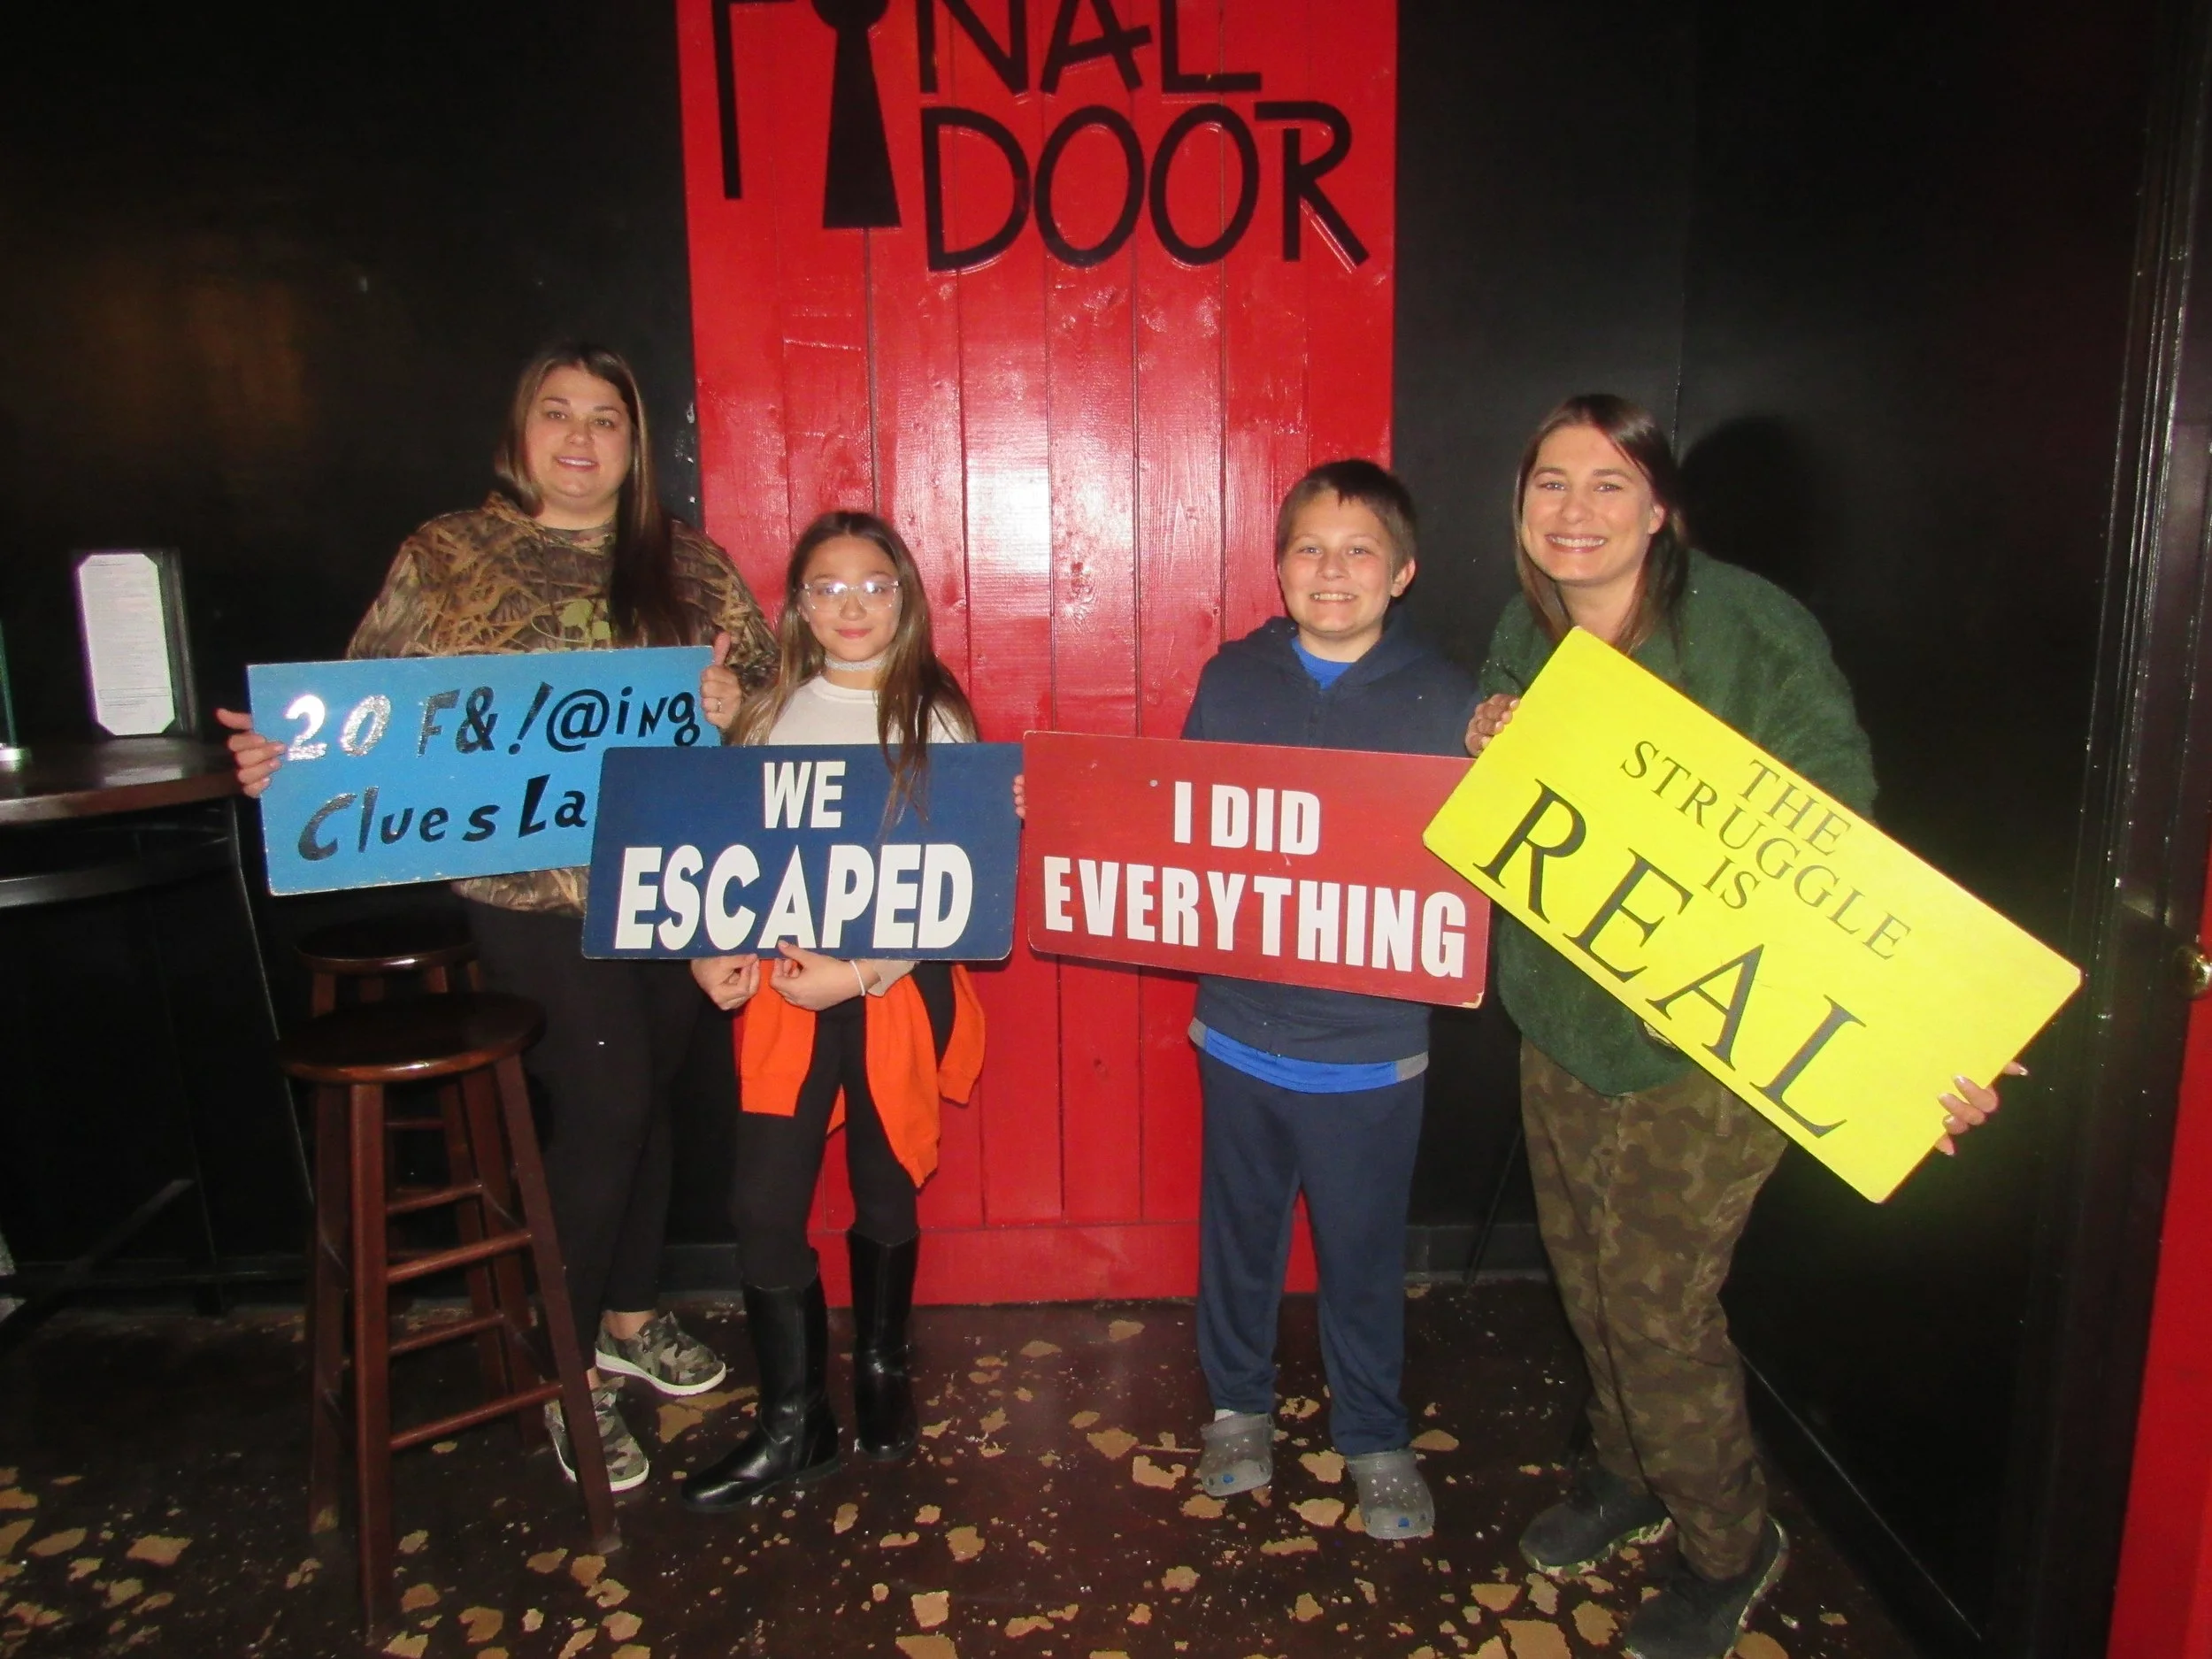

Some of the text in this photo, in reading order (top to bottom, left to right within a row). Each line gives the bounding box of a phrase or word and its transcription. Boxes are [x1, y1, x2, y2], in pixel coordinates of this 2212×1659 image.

[920, 104, 1370, 273] DOOR
[284, 694, 391, 762] 20
[297, 773, 588, 861] Clues La
[764, 760, 846, 829] WE
[1173, 780, 1321, 856] I DID
[1737, 758, 1852, 856] THE
[614, 843, 973, 951] ESCAPED
[1620, 740, 1912, 961] STRUGGLE
[1701, 856, 1763, 910] IS
[1043, 856, 1467, 979] EVERYTHING
[1472, 778, 1868, 1140] REAL
